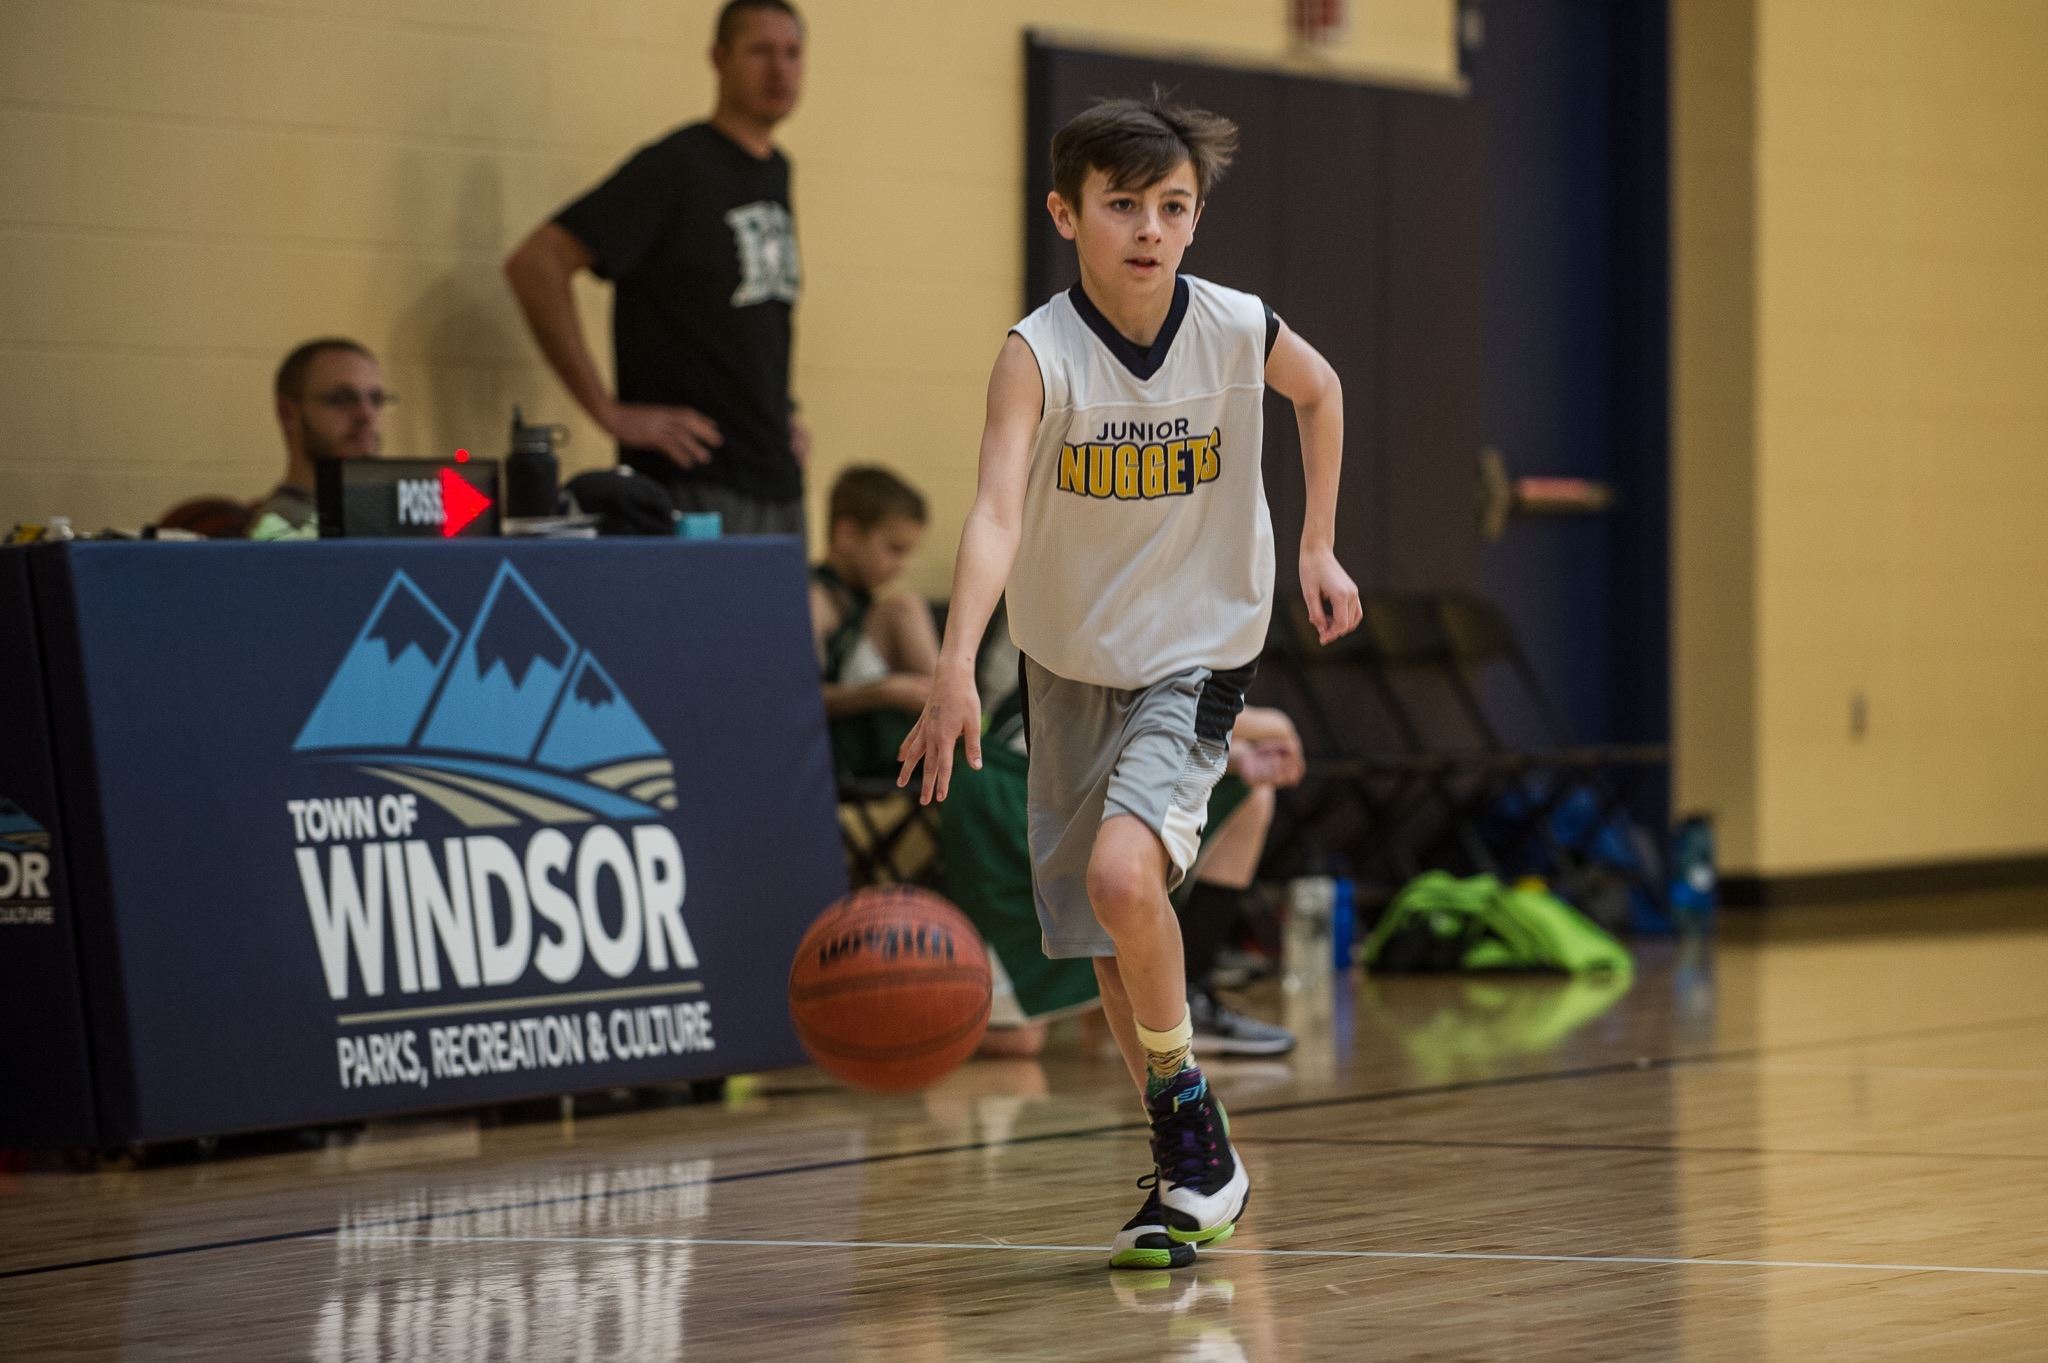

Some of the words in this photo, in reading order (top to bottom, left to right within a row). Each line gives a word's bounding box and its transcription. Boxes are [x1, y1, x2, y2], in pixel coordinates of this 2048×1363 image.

[1057, 427, 1221, 500] NUGGETS
[1097, 418, 1190, 441] JUNIOR
[288, 797, 377, 842] TOWN
[378, 793, 418, 837] OF
[296, 825, 699, 1000] WINDSOR
[337, 1028, 429, 1088] PARKS,
[429, 1015, 585, 1079] RECREATION
[586, 1011, 610, 1062] &
[609, 1001, 715, 1060] CULTURE
